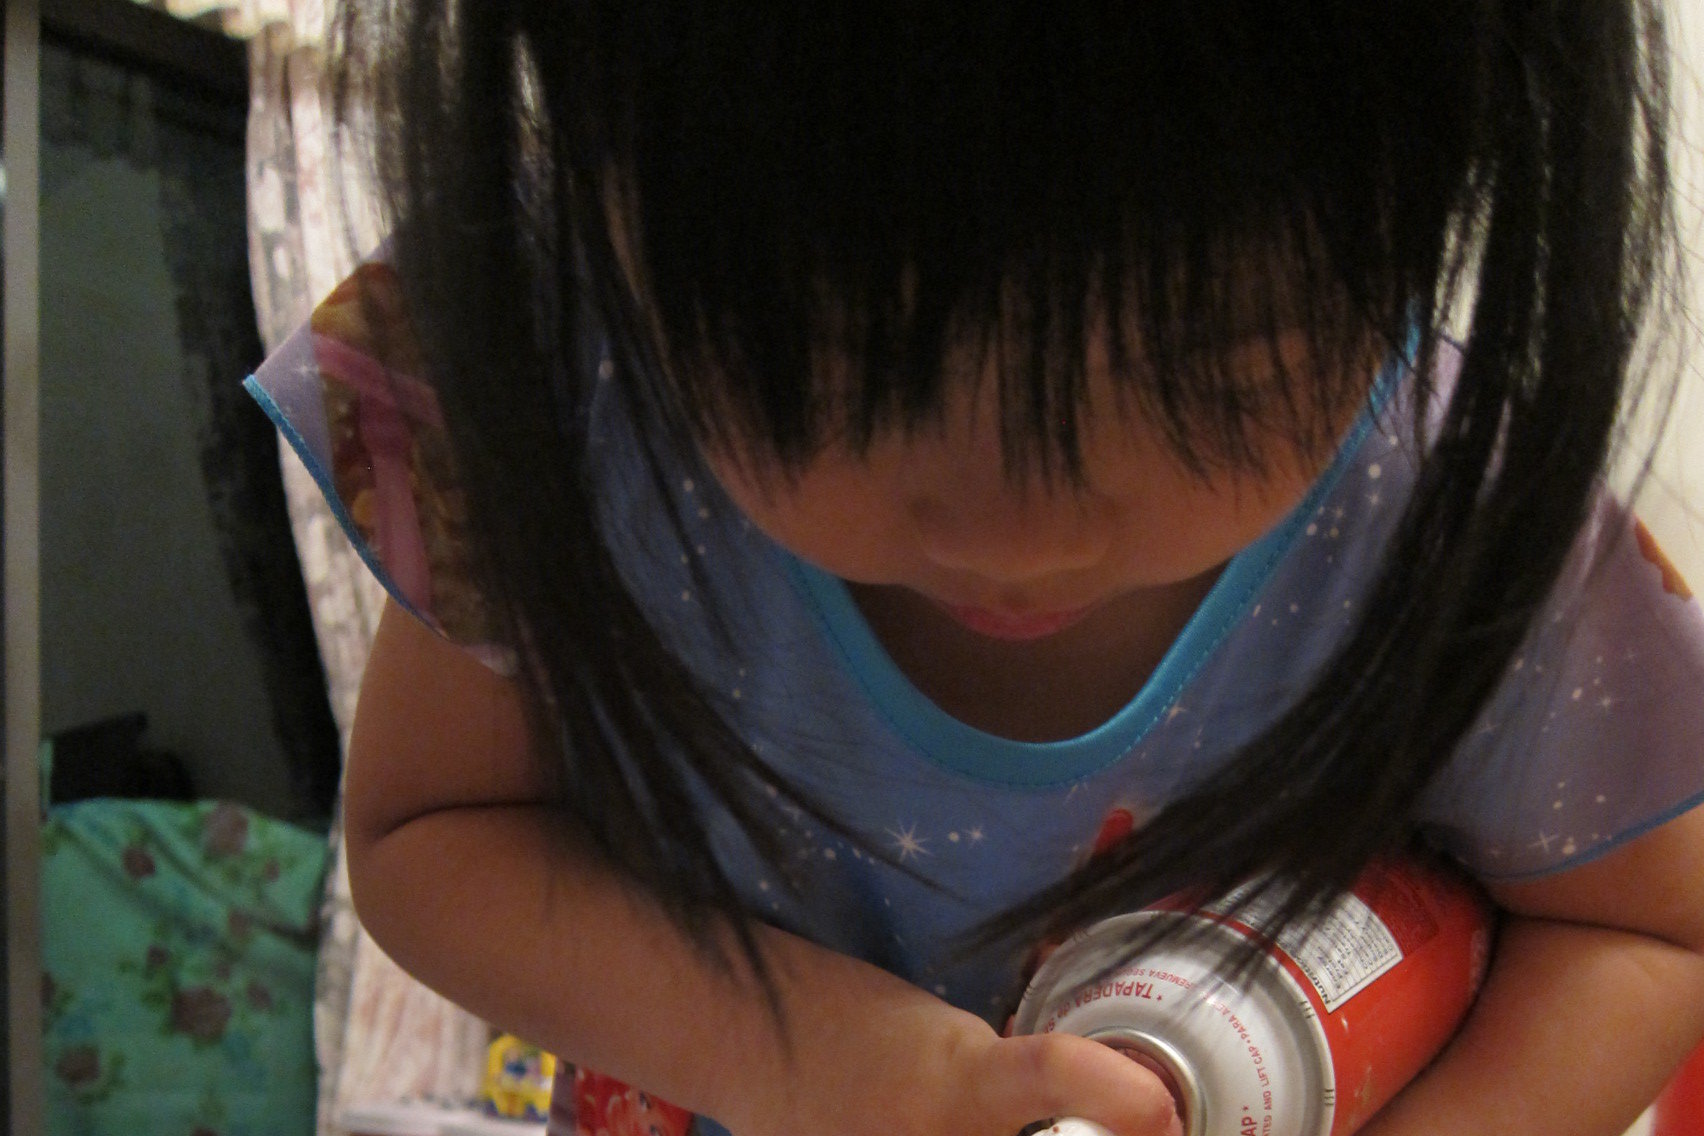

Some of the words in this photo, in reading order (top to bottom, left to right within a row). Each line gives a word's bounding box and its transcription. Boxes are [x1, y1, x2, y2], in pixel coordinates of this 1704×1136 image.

[1149, 968, 1193, 990] REMUEVA
[1075, 980, 1154, 1008] TAPADERA
[1228, 1014, 1250, 1041] PARA
[1249, 1046, 1263, 1065] CAP
[1256, 1065, 1271, 1087] LIFT
[1264, 1090, 1272, 1110] AND
